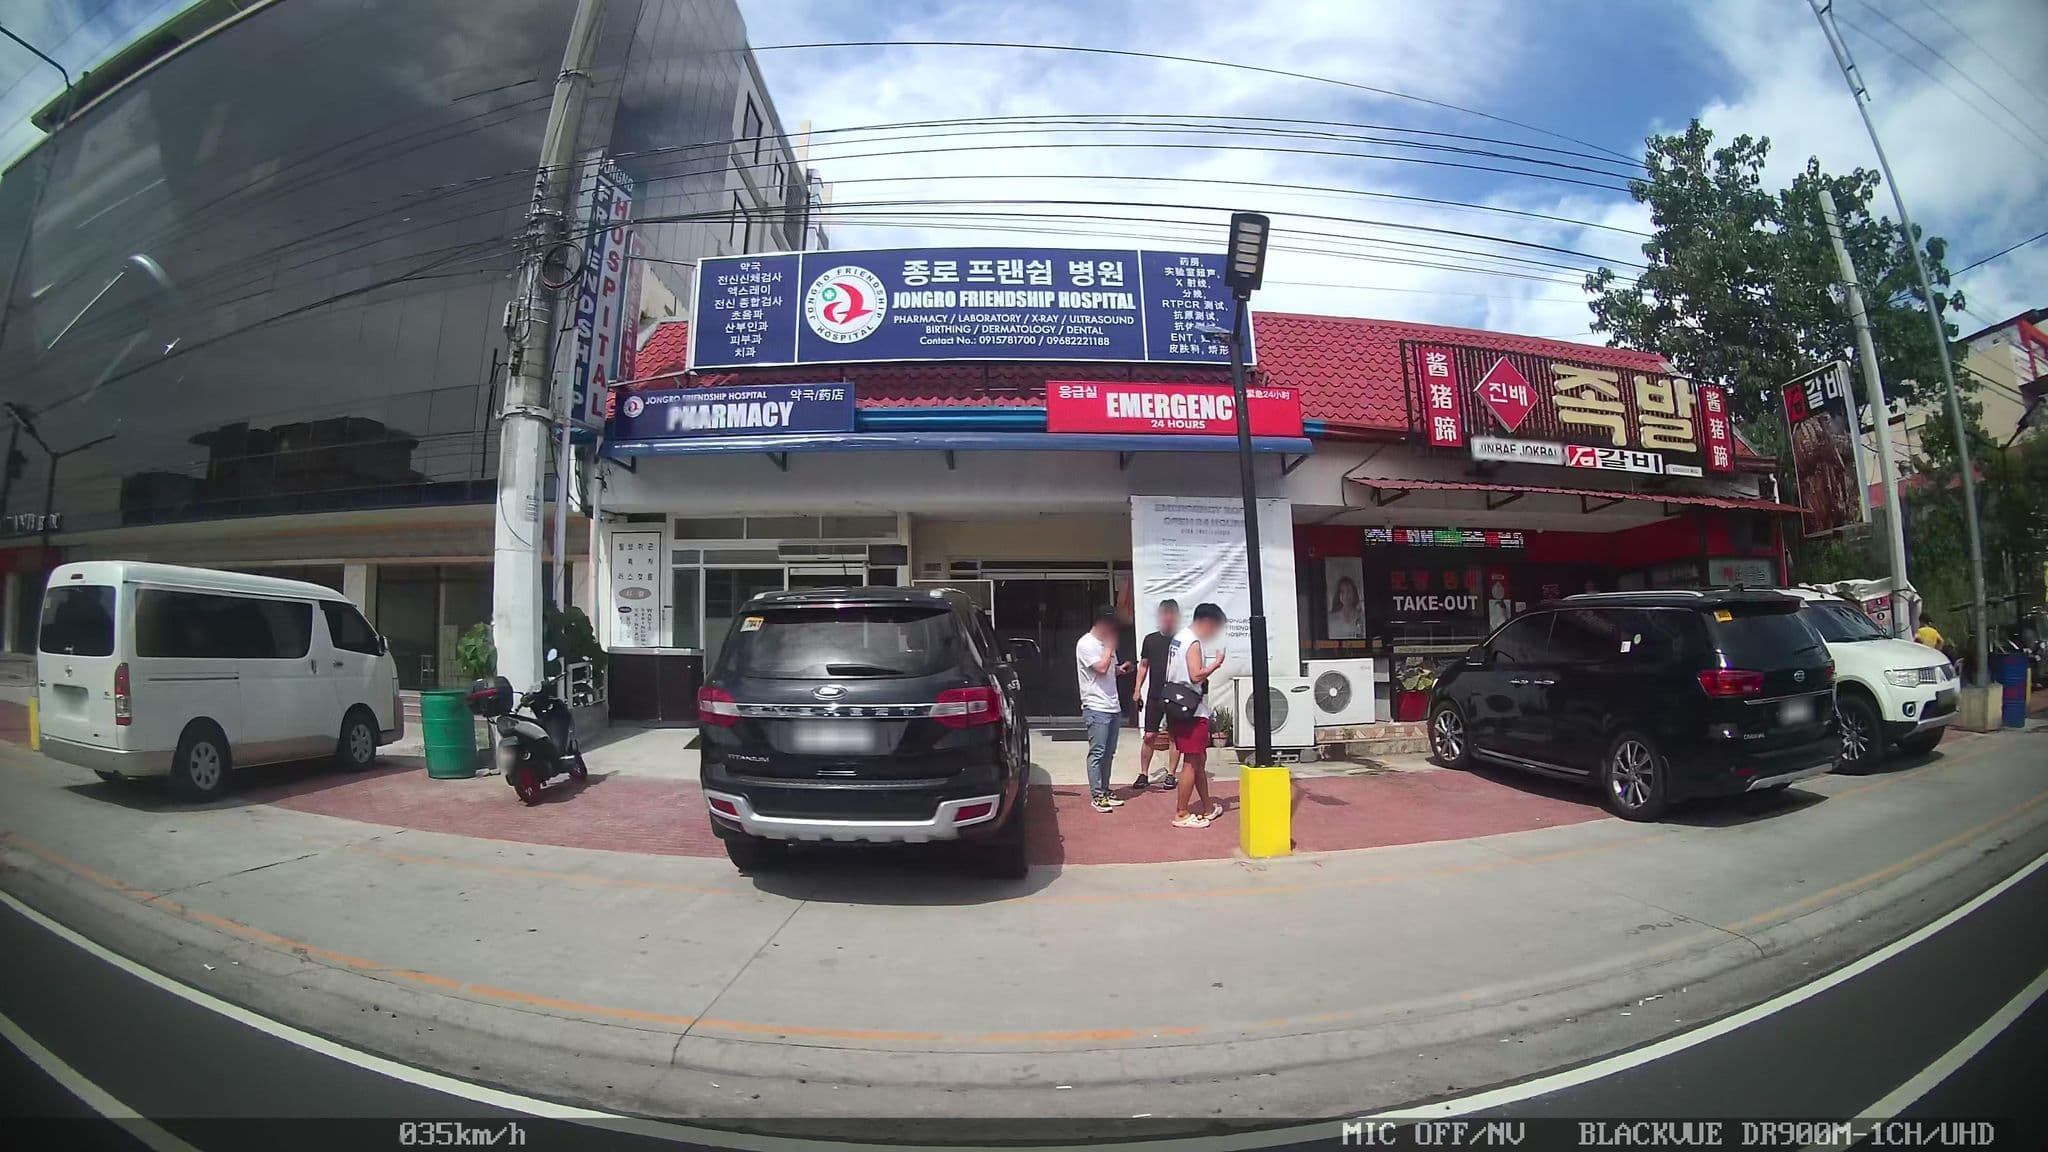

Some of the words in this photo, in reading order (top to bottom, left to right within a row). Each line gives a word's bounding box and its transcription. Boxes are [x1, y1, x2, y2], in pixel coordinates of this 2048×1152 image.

[740, 262, 761, 271] 약국
[902, 260, 960, 287] 종로
[967, 259, 1053, 287] 프랜쉽
[1068, 260, 1124, 287] 병원
[718, 272, 783, 285] 전신신체검사
[1176, 279, 1183, 287] X
[728, 285, 770, 296] 엑스레이
[808, 275, 830, 321] JONGRO
[837, 268, 885, 319] FRIENDSHIP
[714, 299, 736, 309] 전신
[739, 296, 783, 308] 종합검사
[892, 291, 956, 309] JONGRO
[959, 290, 1055, 308] FRIENDSHIP
[1058, 291, 1136, 310] HOSPITAL
[1162, 300, 1200, 309] RTPCR
[591, 200, 628, 418] HOSPITAL
[731, 309, 764, 320] 초음파
[893, 315, 948, 324] PHARMACY
[958, 314, 1022, 324] LABORATORY
[1031, 315, 1059, 324] X-RAY
[1069, 315, 1135, 326] ULTRASOUND
[725, 321, 768, 333] 산부인과
[817, 326, 874, 341] HOSPITAL
[926, 325, 971, 334] BIRTHING
[982, 325, 1056, 335] DERMATOLOGY
[1067, 326, 1105, 335] DENTAL
[730, 334, 762, 345] 피부과
[920, 336, 954, 345] Contact
[958, 336, 976, 345] No.:
[979, 336, 1036, 346] 0915781700
[1046, 336, 1110, 346] 09682221188
[735, 347, 757, 357] 치과
[1058, 385, 1098, 399] 응급실
[1488, 382, 1529, 407] 진배
[1804, 367, 1843, 410] 갈비
[645, 394, 681, 406] JONGRO
[728, 391, 768, 400] HOSPITAL
[789, 389, 844, 402] 약국/药店
[1426, 352, 1457, 442] 酱猪蹄
[1105, 392, 1236, 421] EMERGENC
[1551, 363, 1697, 454] 족발
[667, 401, 794, 431] PHARMACY
[1151, 419, 1165, 428] 24
[1167, 419, 1206, 430] HOURS
[1706, 391, 1728, 469] 酱猪蹄
[1392, 595, 1478, 611] TAKE-OUT
